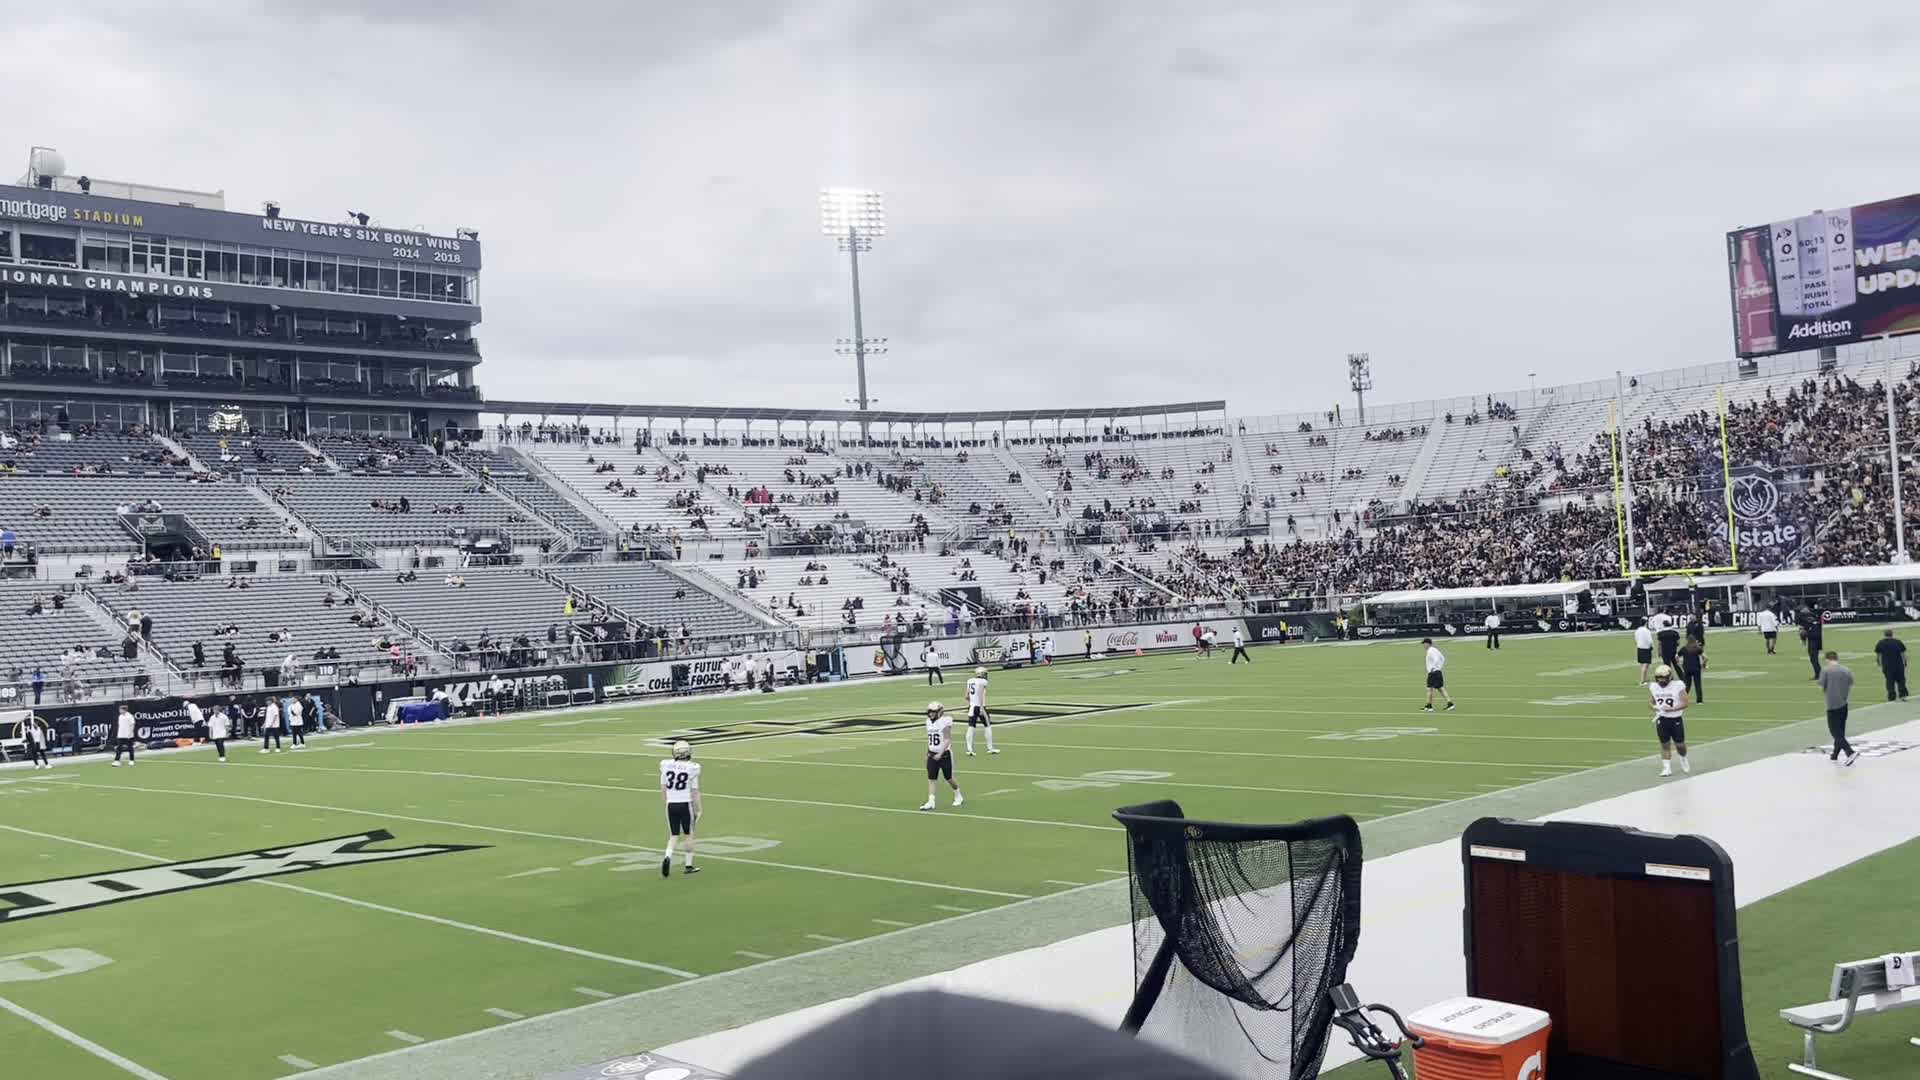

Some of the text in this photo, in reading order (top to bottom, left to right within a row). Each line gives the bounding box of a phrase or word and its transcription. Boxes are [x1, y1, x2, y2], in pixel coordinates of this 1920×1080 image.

[73, 209, 143, 226] STADIUM
[263, 219, 460, 251] NEW YEAR'S SIX BOWL WINS
[393, 247, 461, 264] 2014 2018
[2, 269, 213, 299] IONAL CHAMPIONS
[1804, 281, 1827, 290] PASS
[1804, 291, 1829, 299] RUSH
[1803, 300, 1831, 310] TOTAL
[1788, 320, 1851, 339] Addition
[1156, 633, 1178, 643] Wawa
[980, 649, 1002, 662] UCF
[134, 710, 178, 720] ORLANDO
[665, 770, 688, 790] 38
